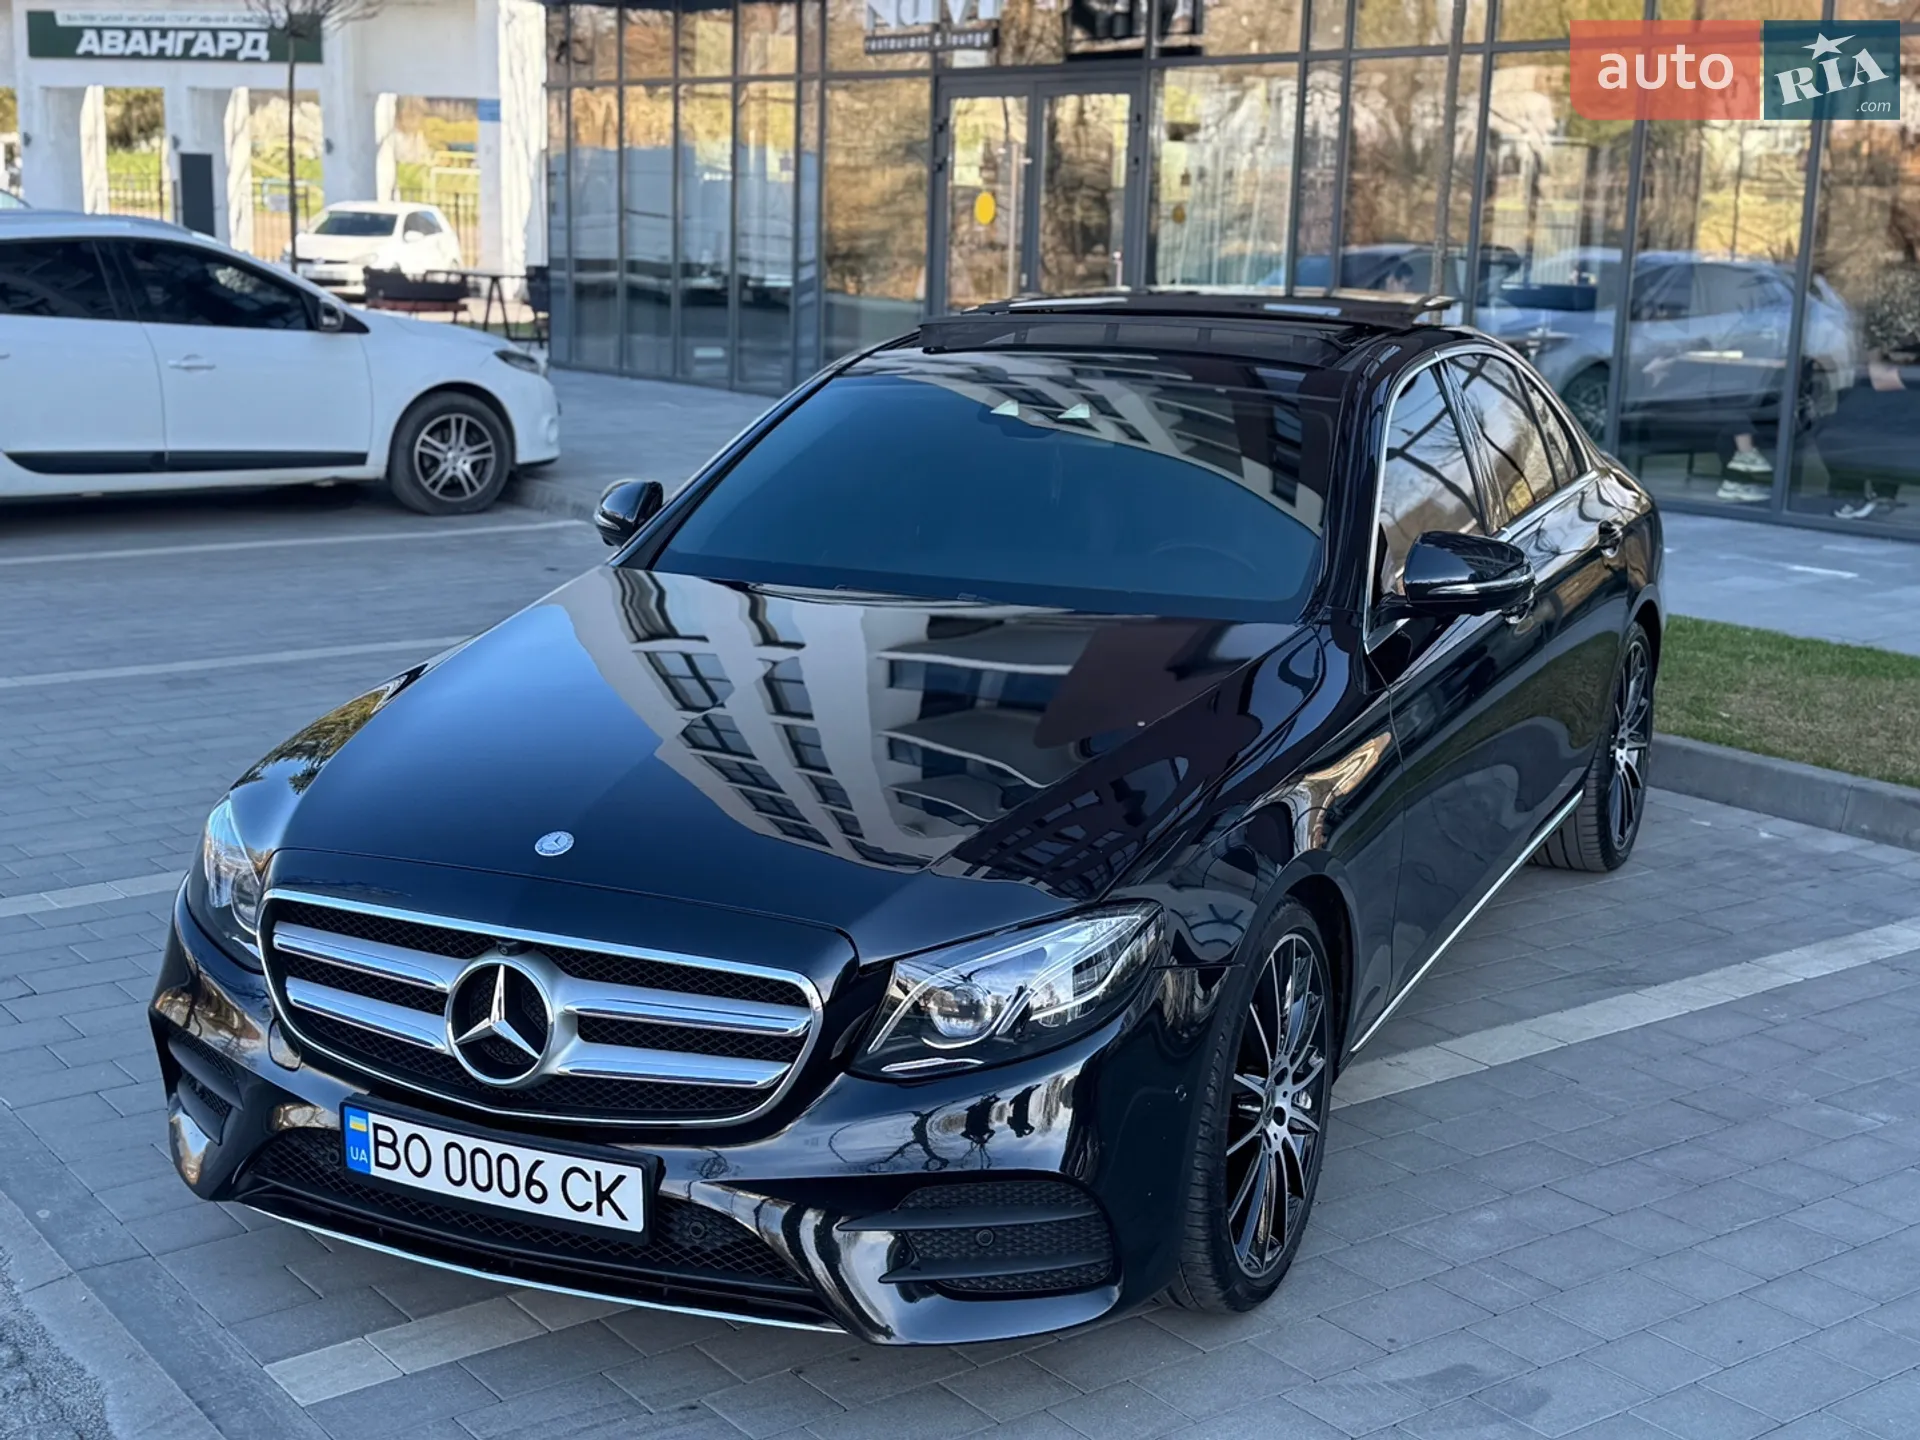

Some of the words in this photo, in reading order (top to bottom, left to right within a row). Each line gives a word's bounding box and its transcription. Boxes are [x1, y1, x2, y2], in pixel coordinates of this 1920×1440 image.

[75, 28, 270, 61] АВАНГАРД
[350, 1145, 368, 1164] UA
[372, 1122, 432, 1178] BO
[444, 1141, 548, 1204] 0006
[561, 1166, 629, 1222] CK
